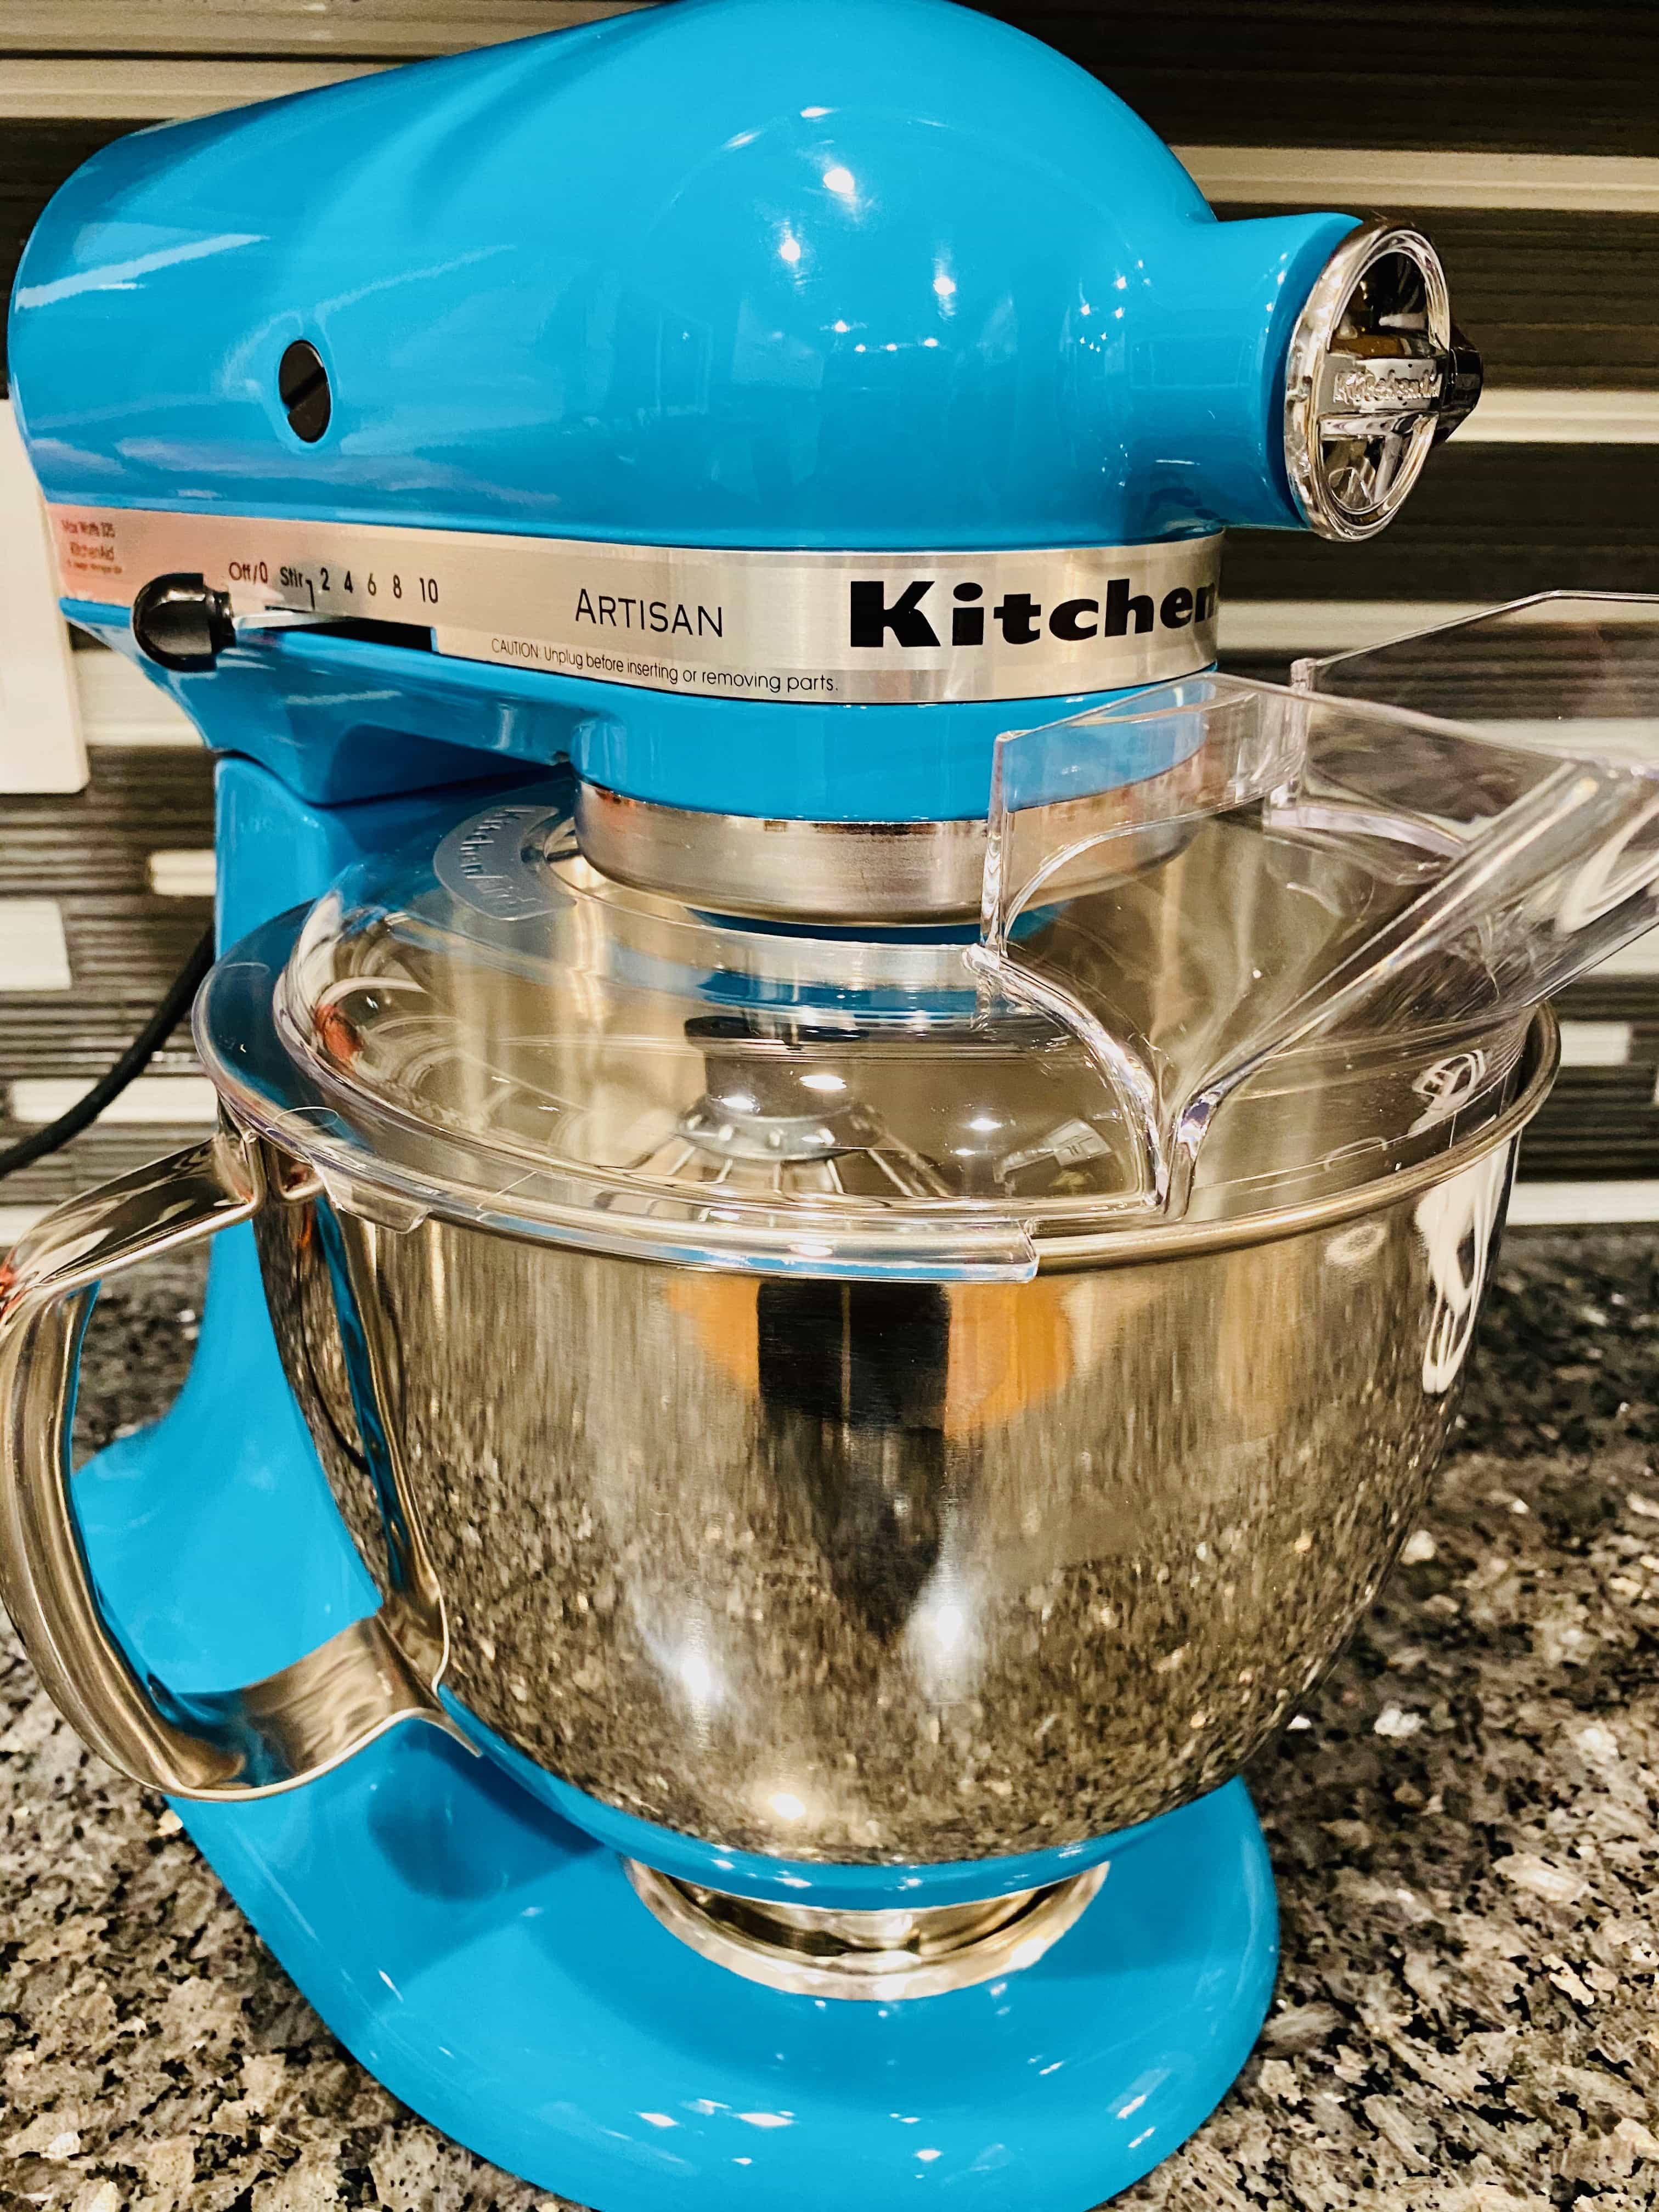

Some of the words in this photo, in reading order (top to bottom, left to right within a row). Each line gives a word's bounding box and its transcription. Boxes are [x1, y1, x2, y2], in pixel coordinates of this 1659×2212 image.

[280, 566, 304, 588] Stir
[320, 567, 330, 591] 2
[344, 571, 354, 594] 4
[367, 573, 377, 596] 6
[393, 574, 402, 599] 8
[420, 578, 438, 604] 10
[544, 646, 583, 670] Unplug
[586, 652, 624, 673] before
[627, 658, 678, 685] inserting
[683, 669, 697, 682] or
[702, 671, 781, 693] removing
[787, 674, 839, 693] parts.
